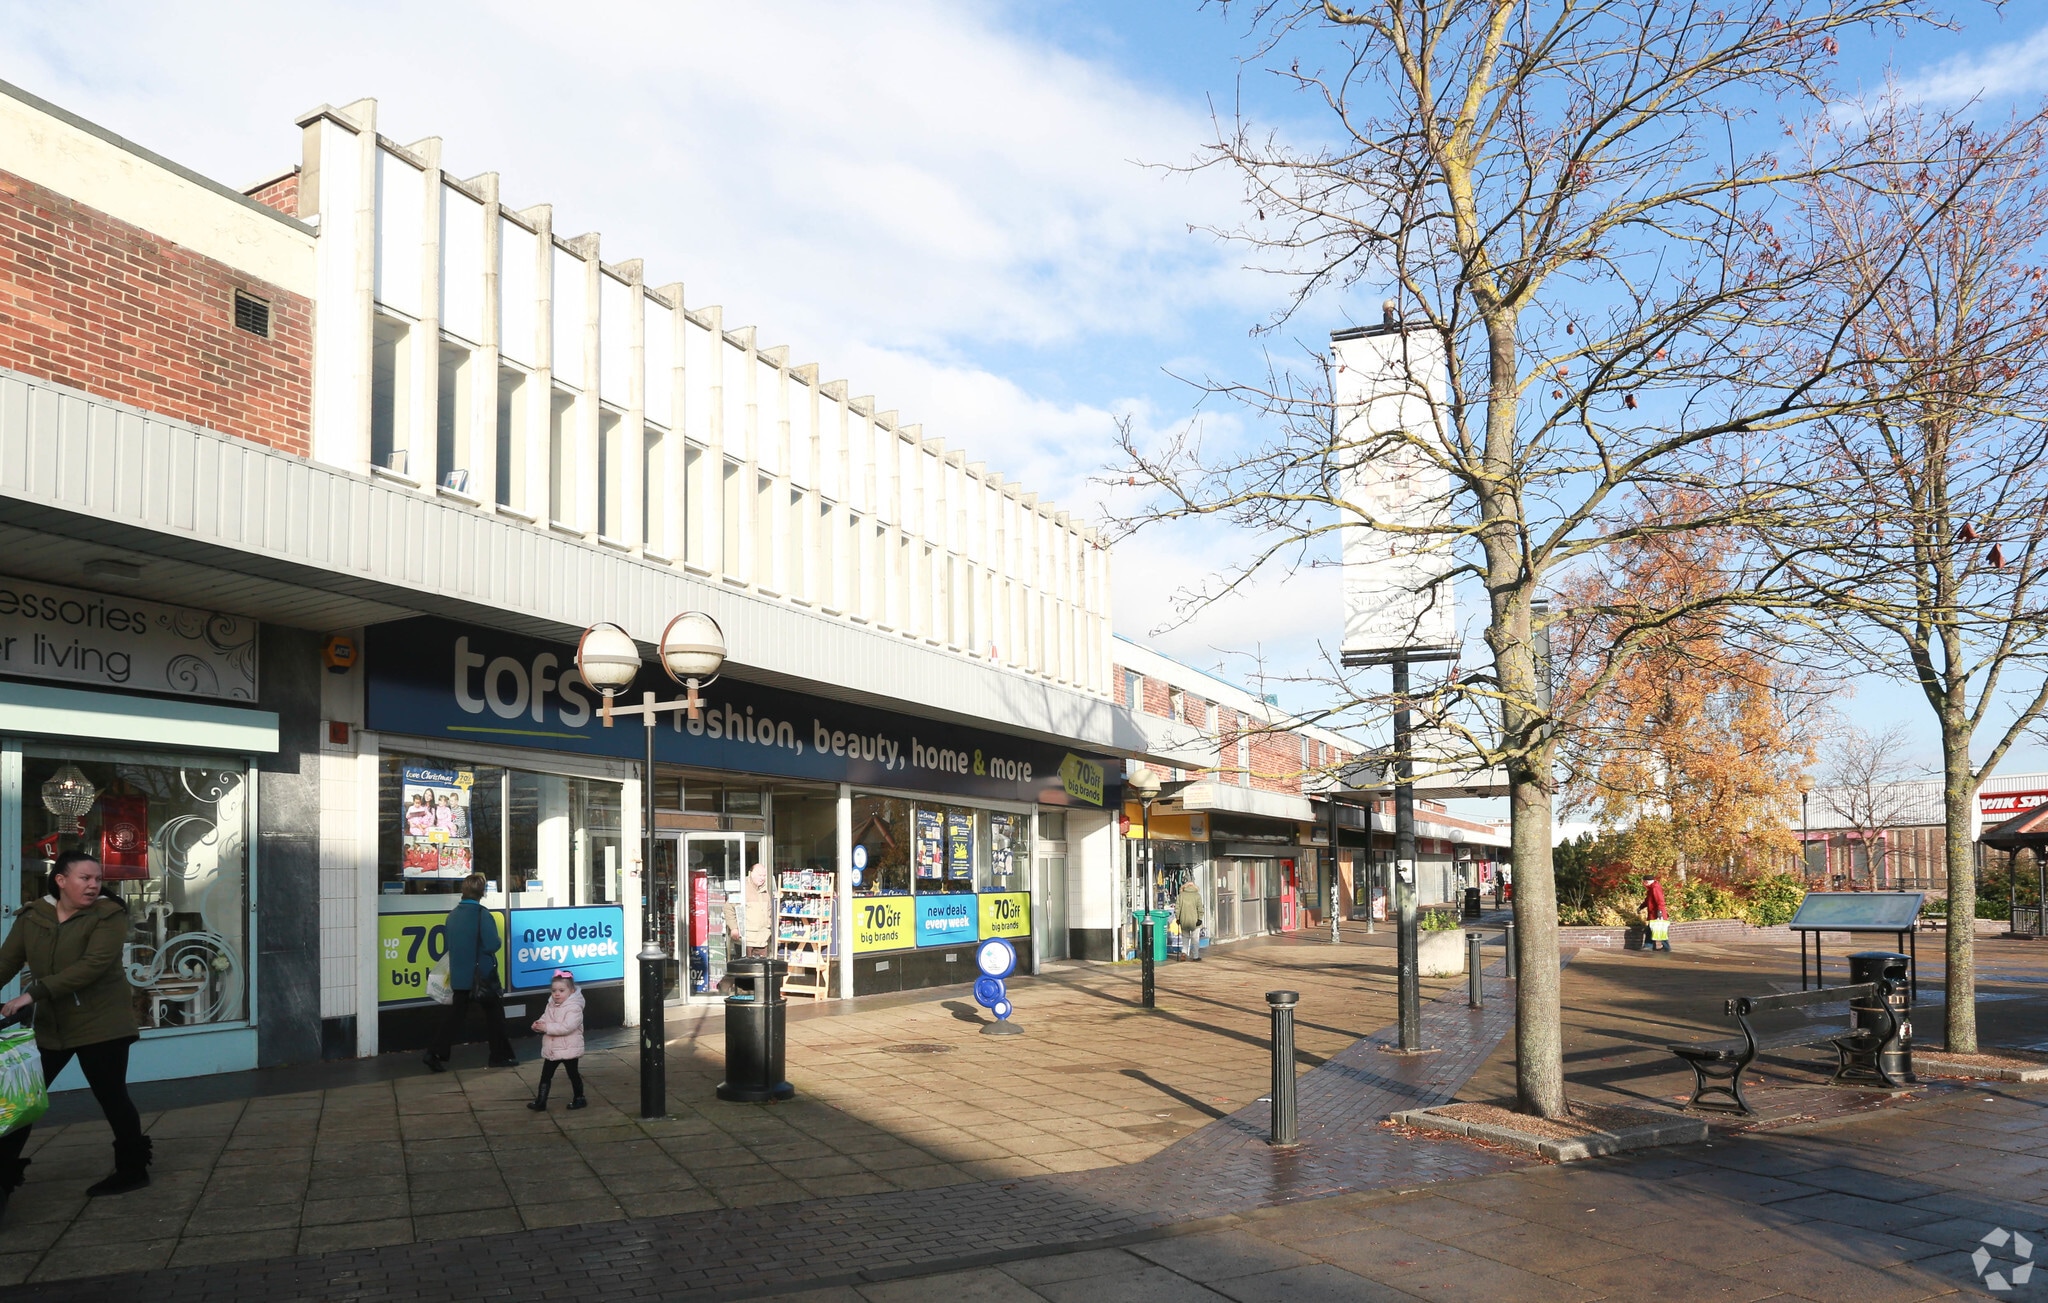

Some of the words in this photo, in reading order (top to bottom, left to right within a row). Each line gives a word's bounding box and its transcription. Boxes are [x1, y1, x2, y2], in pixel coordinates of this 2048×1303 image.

[0, 636, 17, 661] r
[34, 633, 131, 683] living
[455, 635, 591, 728] tofs
[673, 694, 803, 756] fashion,
[813, 718, 906, 771] beauty,
[912, 736, 969, 775] home
[973, 749, 986, 776] &
[991, 757, 1032, 783] more
[1069, 779, 1079, 794] big
[1080, 784, 1100, 801] brands
[1091, 776, 1101, 789] off
[927, 907, 945, 917] new
[946, 904, 967, 916] deals
[1010, 905, 1021, 918] off
[887, 912, 901, 927] off
[925, 918, 948, 931] every
[948, 915, 970, 928] week
[991, 922, 1001, 932] big
[1001, 921, 1019, 930] brands
[523, 928, 562, 943] new
[567, 922, 612, 941] deals
[860, 932, 873, 944] big
[875, 930, 899, 942] brands
[383, 938, 400, 949] up
[518, 944, 569, 964] every
[571, 938, 618, 959] week
[385, 949, 399, 959] to
[392, 968, 421, 988] big
